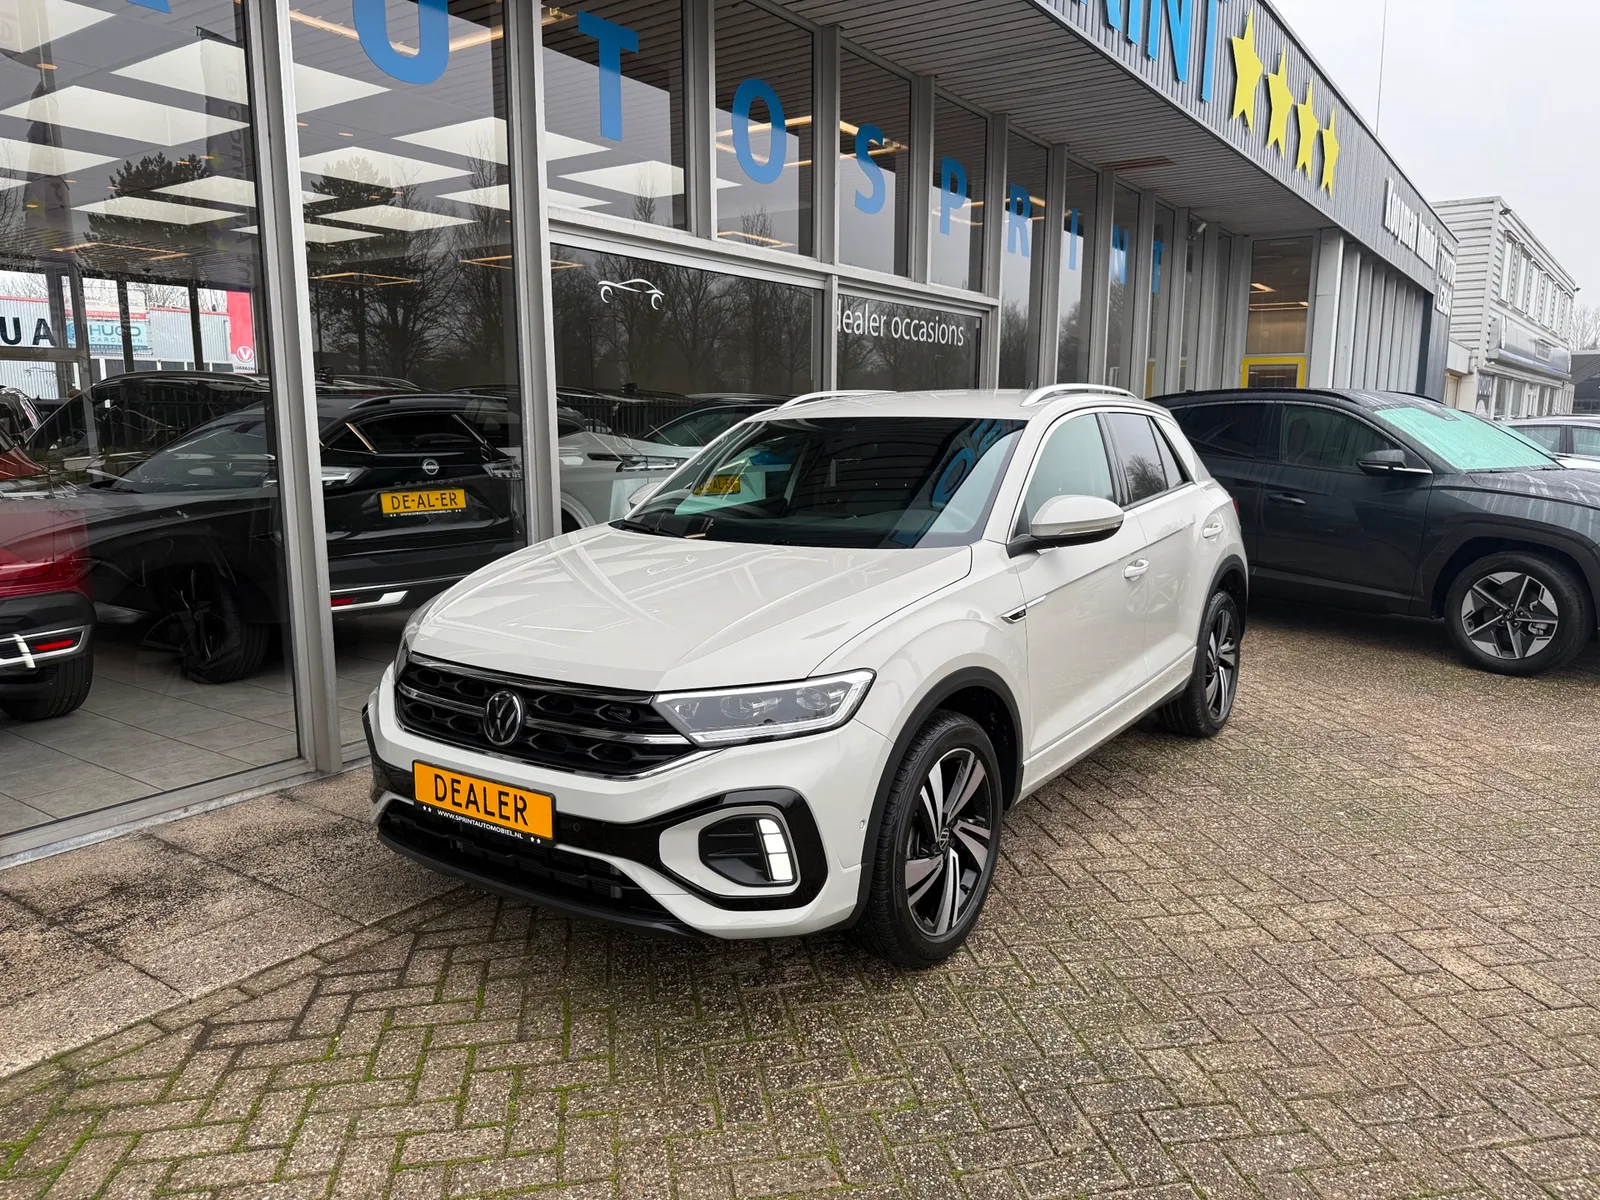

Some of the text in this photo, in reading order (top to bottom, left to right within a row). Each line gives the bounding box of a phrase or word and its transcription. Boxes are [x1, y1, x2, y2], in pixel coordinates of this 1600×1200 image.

[891, 316, 964, 347] occasions
[390, 492, 458, 510] DE-AL-ER
[433, 773, 529, 826] DEALER
